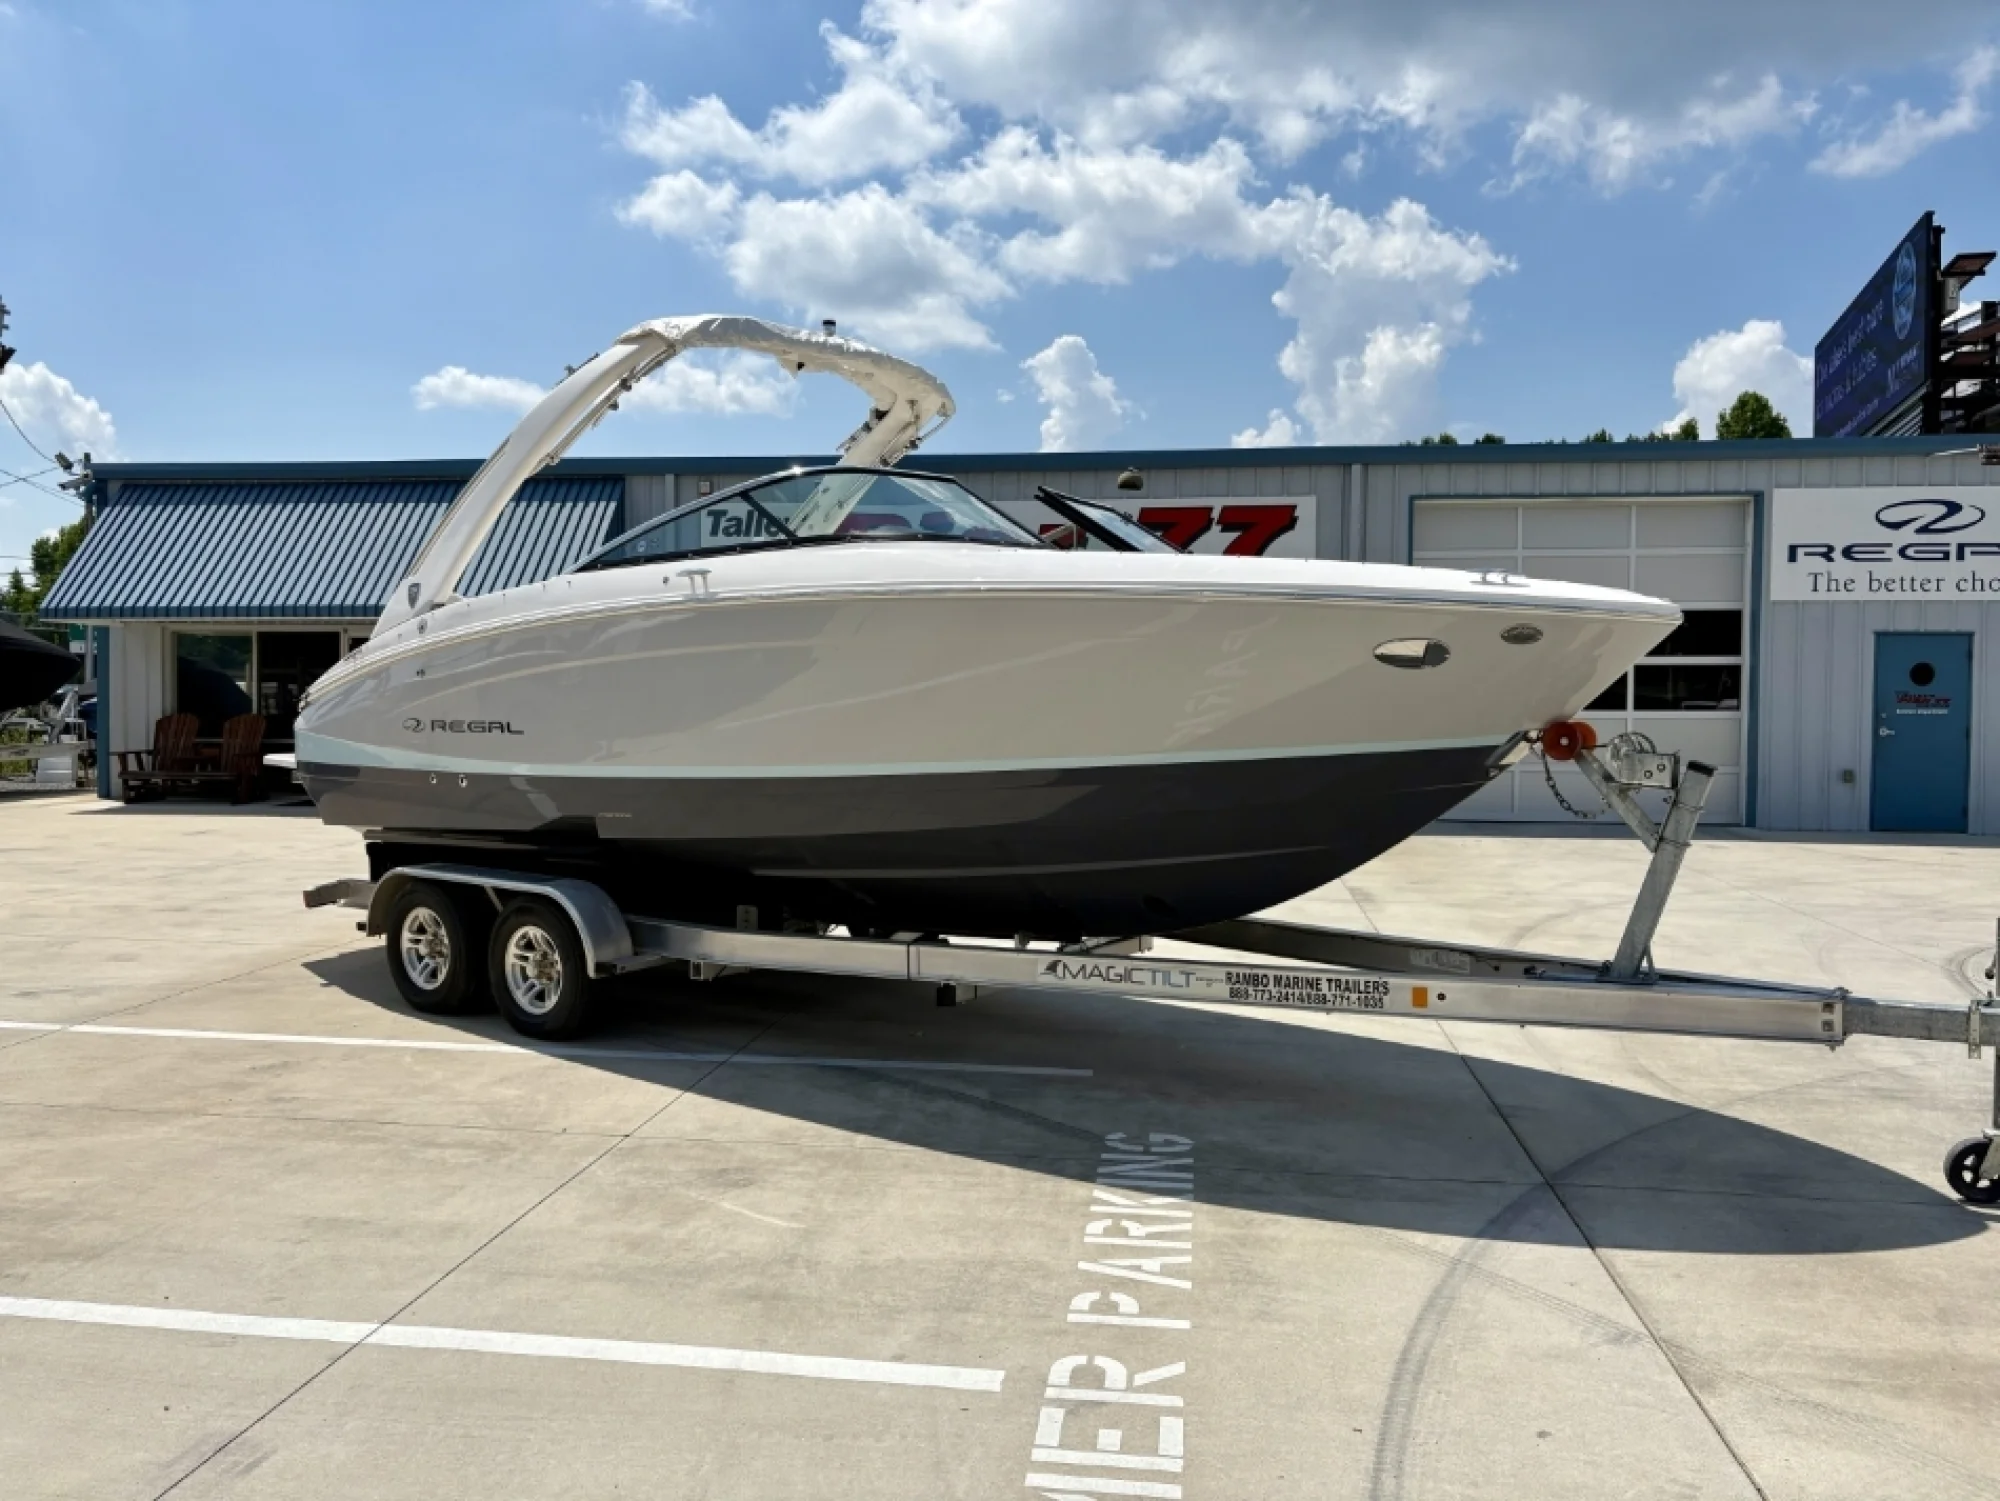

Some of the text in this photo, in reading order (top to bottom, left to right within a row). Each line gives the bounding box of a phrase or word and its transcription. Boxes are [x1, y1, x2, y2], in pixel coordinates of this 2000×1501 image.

[1807, 570, 1856, 593] The
[1868, 570, 1945, 593] better
[431, 719, 525, 735] REGAL
[1225, 971, 1270, 988] RAMBO
[1273, 974, 1322, 992] MARINE
[1326, 978, 1390, 997] TRAILERS
[1067, 1132, 1195, 1329] PARKING
